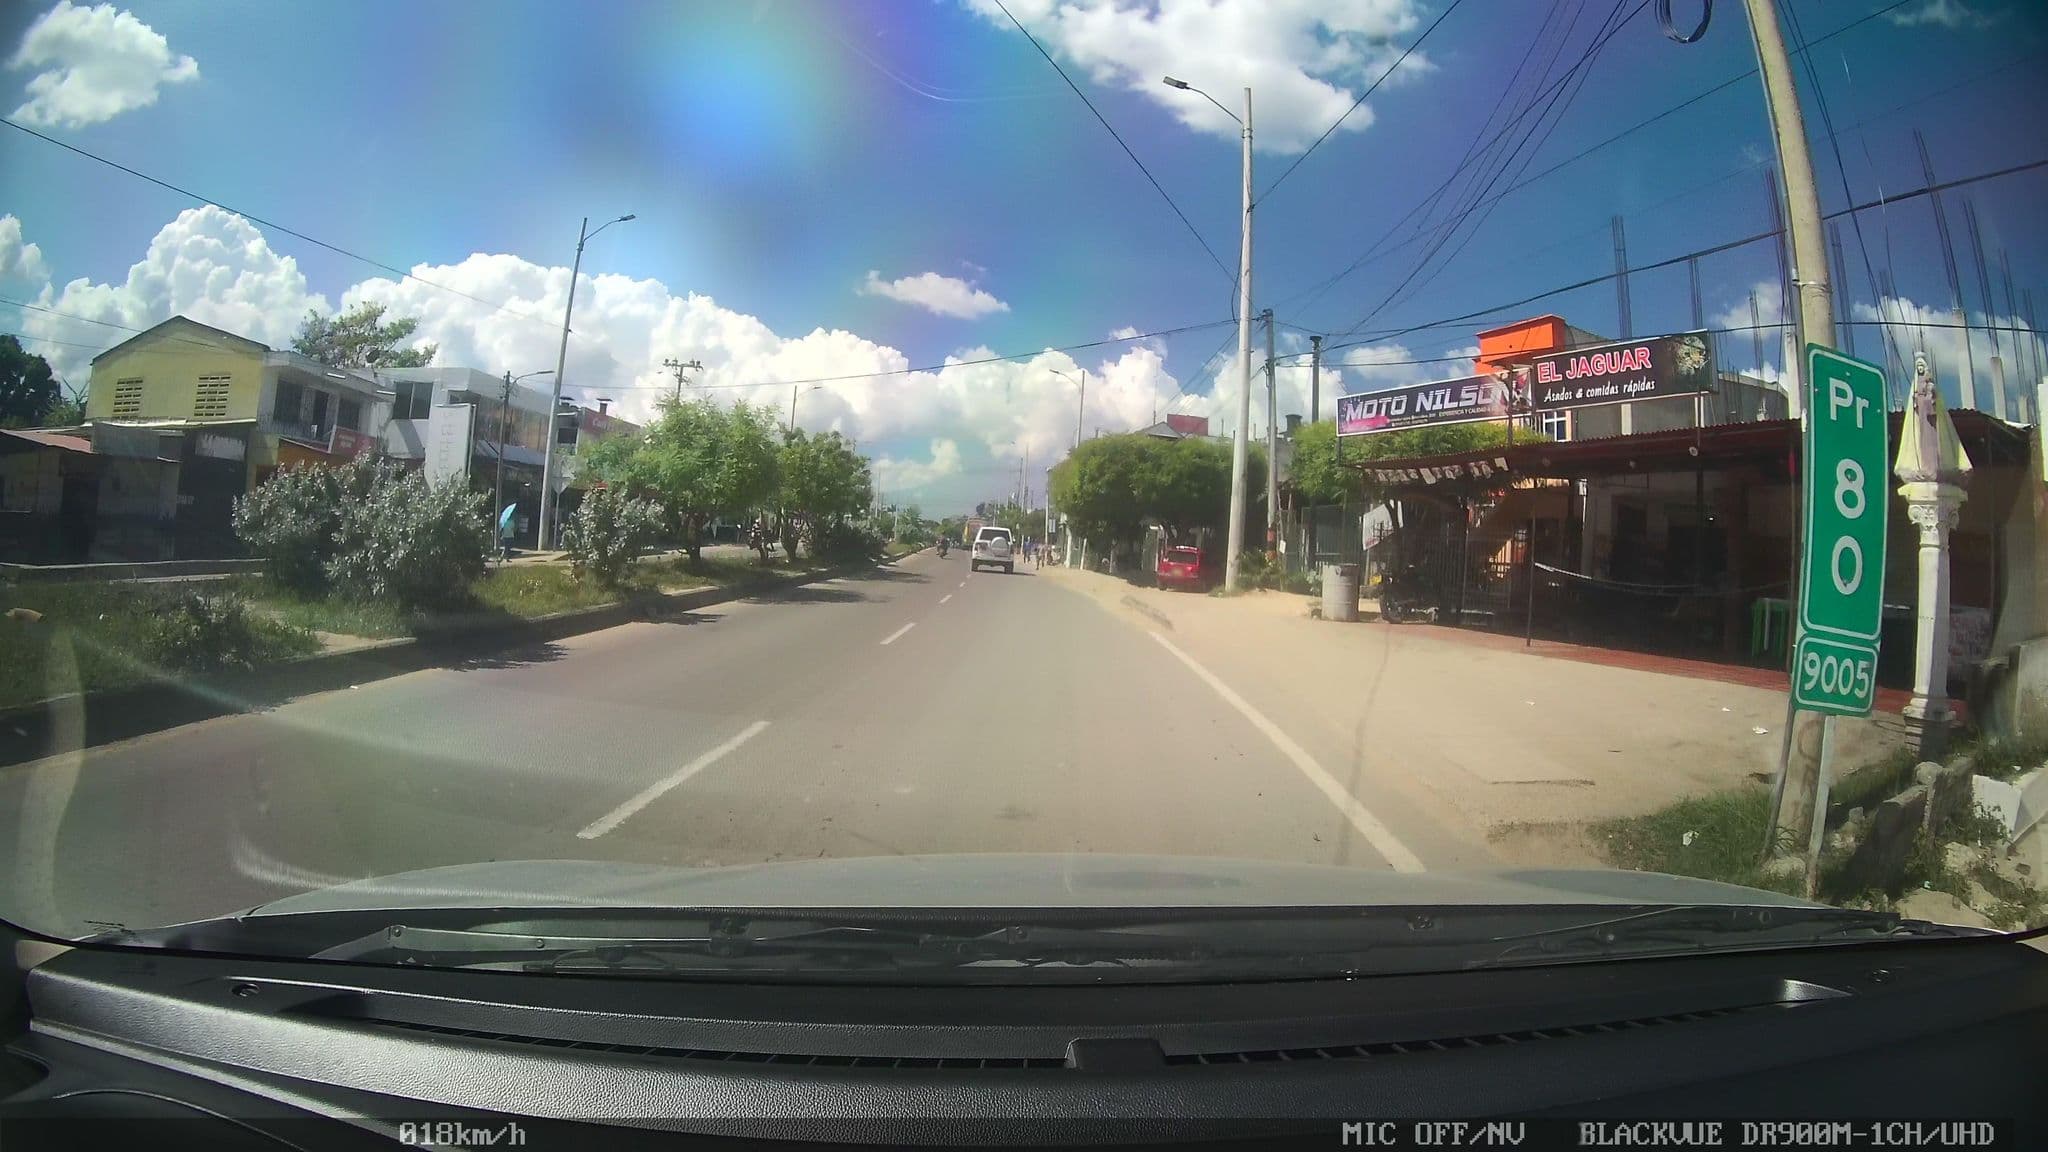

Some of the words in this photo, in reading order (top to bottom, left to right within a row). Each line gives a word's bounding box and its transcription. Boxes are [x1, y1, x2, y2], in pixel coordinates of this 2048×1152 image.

[1537, 361, 1562, 383] EL
[1566, 347, 1652, 379] JAGUAR
[1544, 387, 1572, 403] Asados
[1576, 389, 1583, 399] &
[1586, 380, 1619, 398] comidas
[1623, 375, 1655, 398] rápidas
[1829, 377, 1870, 429] Pr
[1346, 394, 1408, 422] MOTO
[1803, 651, 1871, 698] 9005
